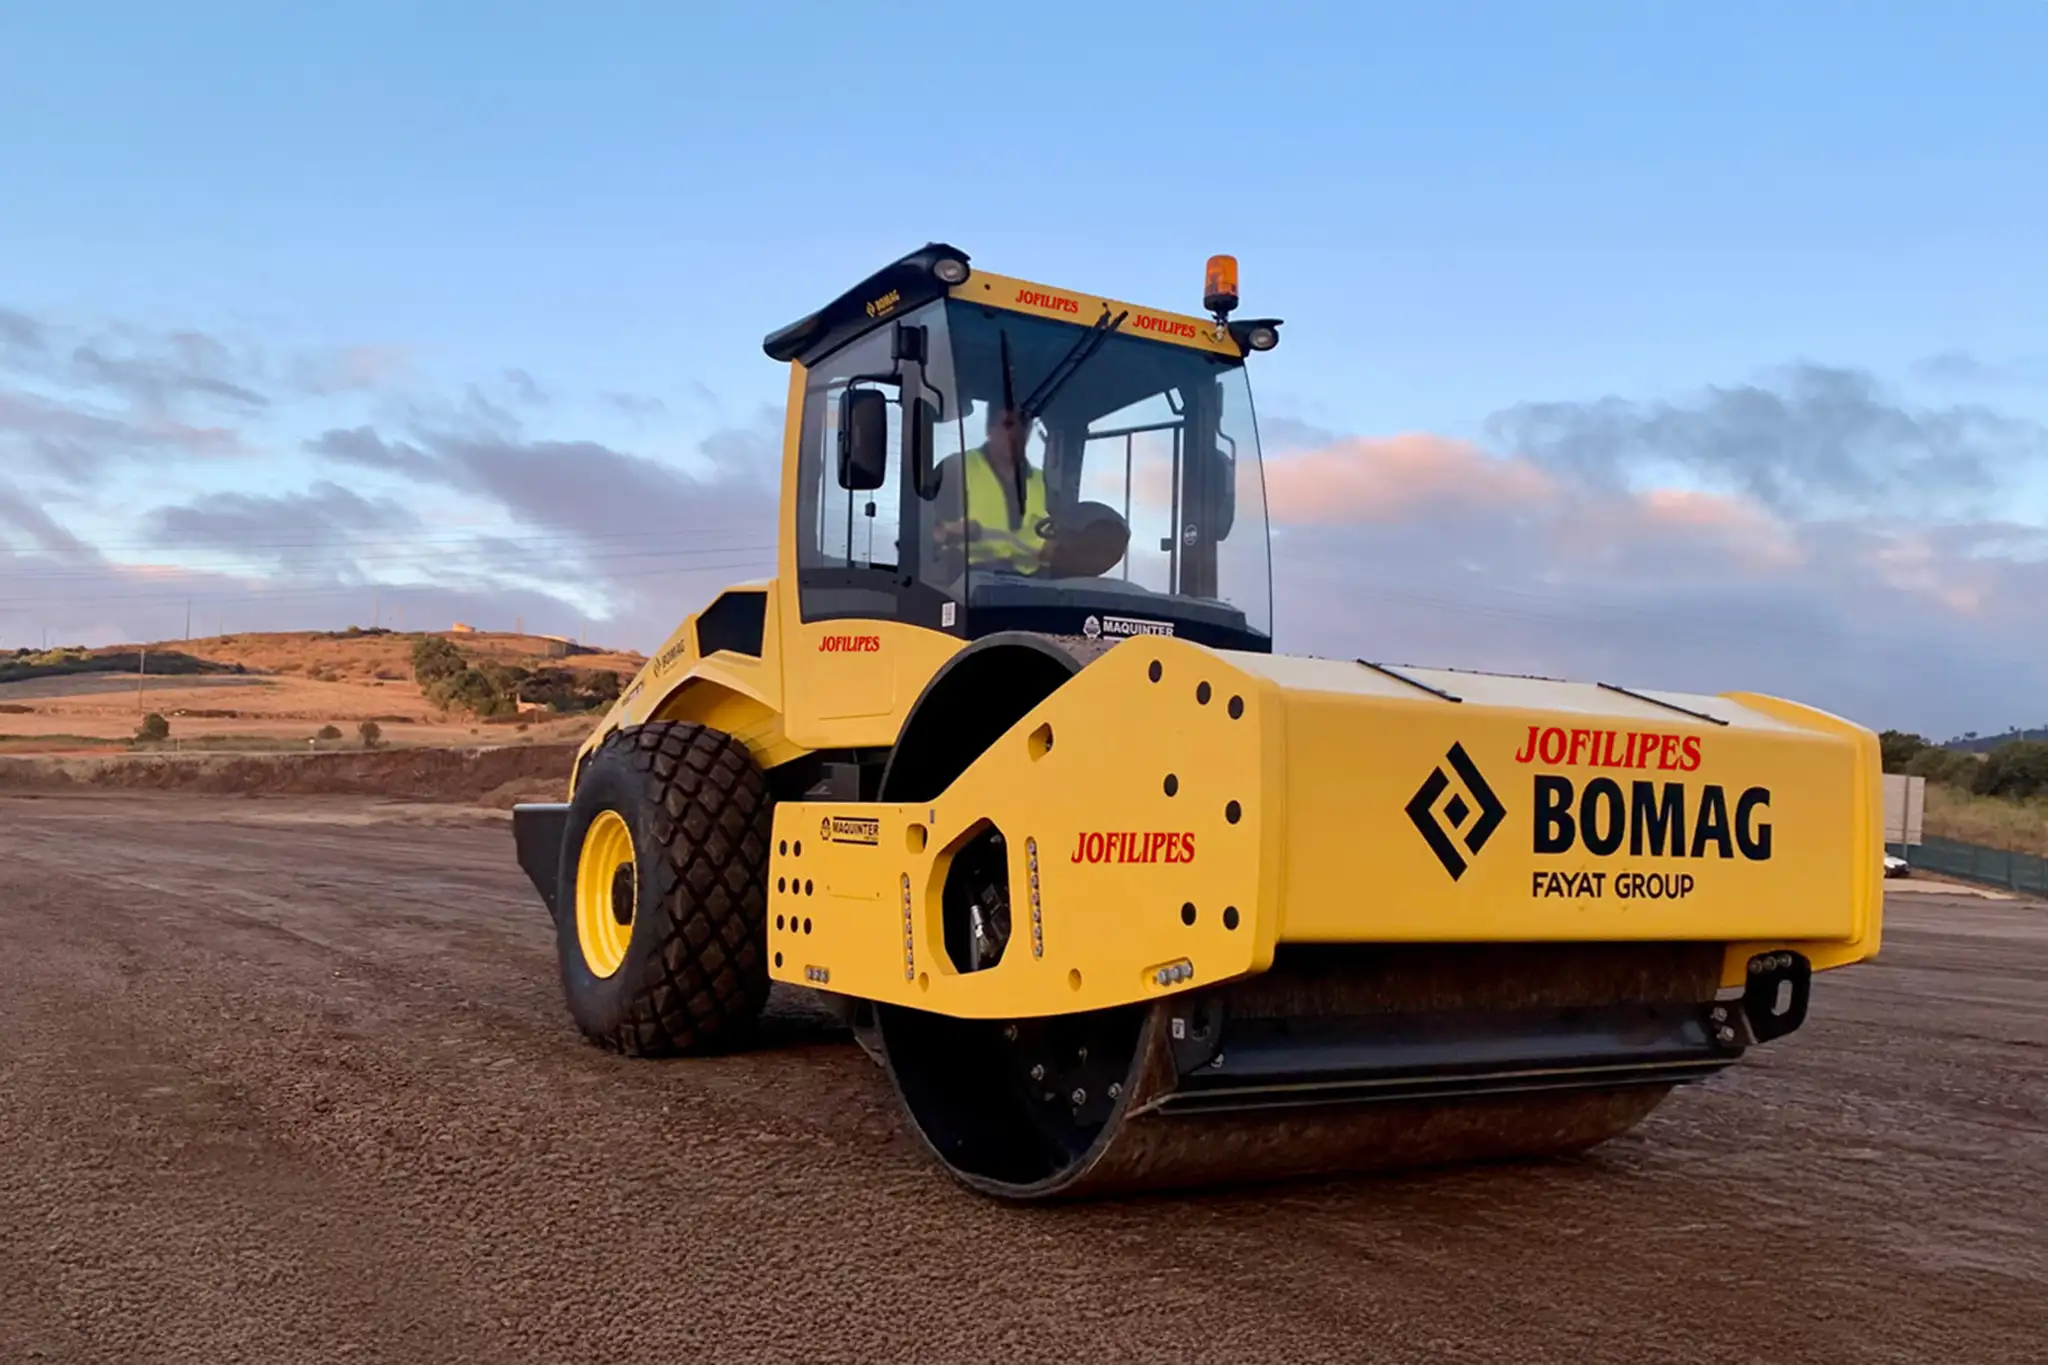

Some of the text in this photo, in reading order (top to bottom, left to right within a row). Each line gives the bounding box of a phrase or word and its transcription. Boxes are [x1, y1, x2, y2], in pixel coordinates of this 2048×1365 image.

[1015, 290, 1079, 314] JOFILIPES
[1132, 314, 1197, 339] JOFILIPES
[1103, 620, 1174, 637] MAQUINTER
[818, 635, 880, 652] JOFILIPES
[1515, 726, 1702, 771] JOFILIPES
[832, 821, 879, 836] MAQUINTER
[1533, 774, 1772, 861] BOMAG
[1071, 832, 1195, 863] JOFILIPES
[1532, 872, 1694, 899] FAYAT GROUP
